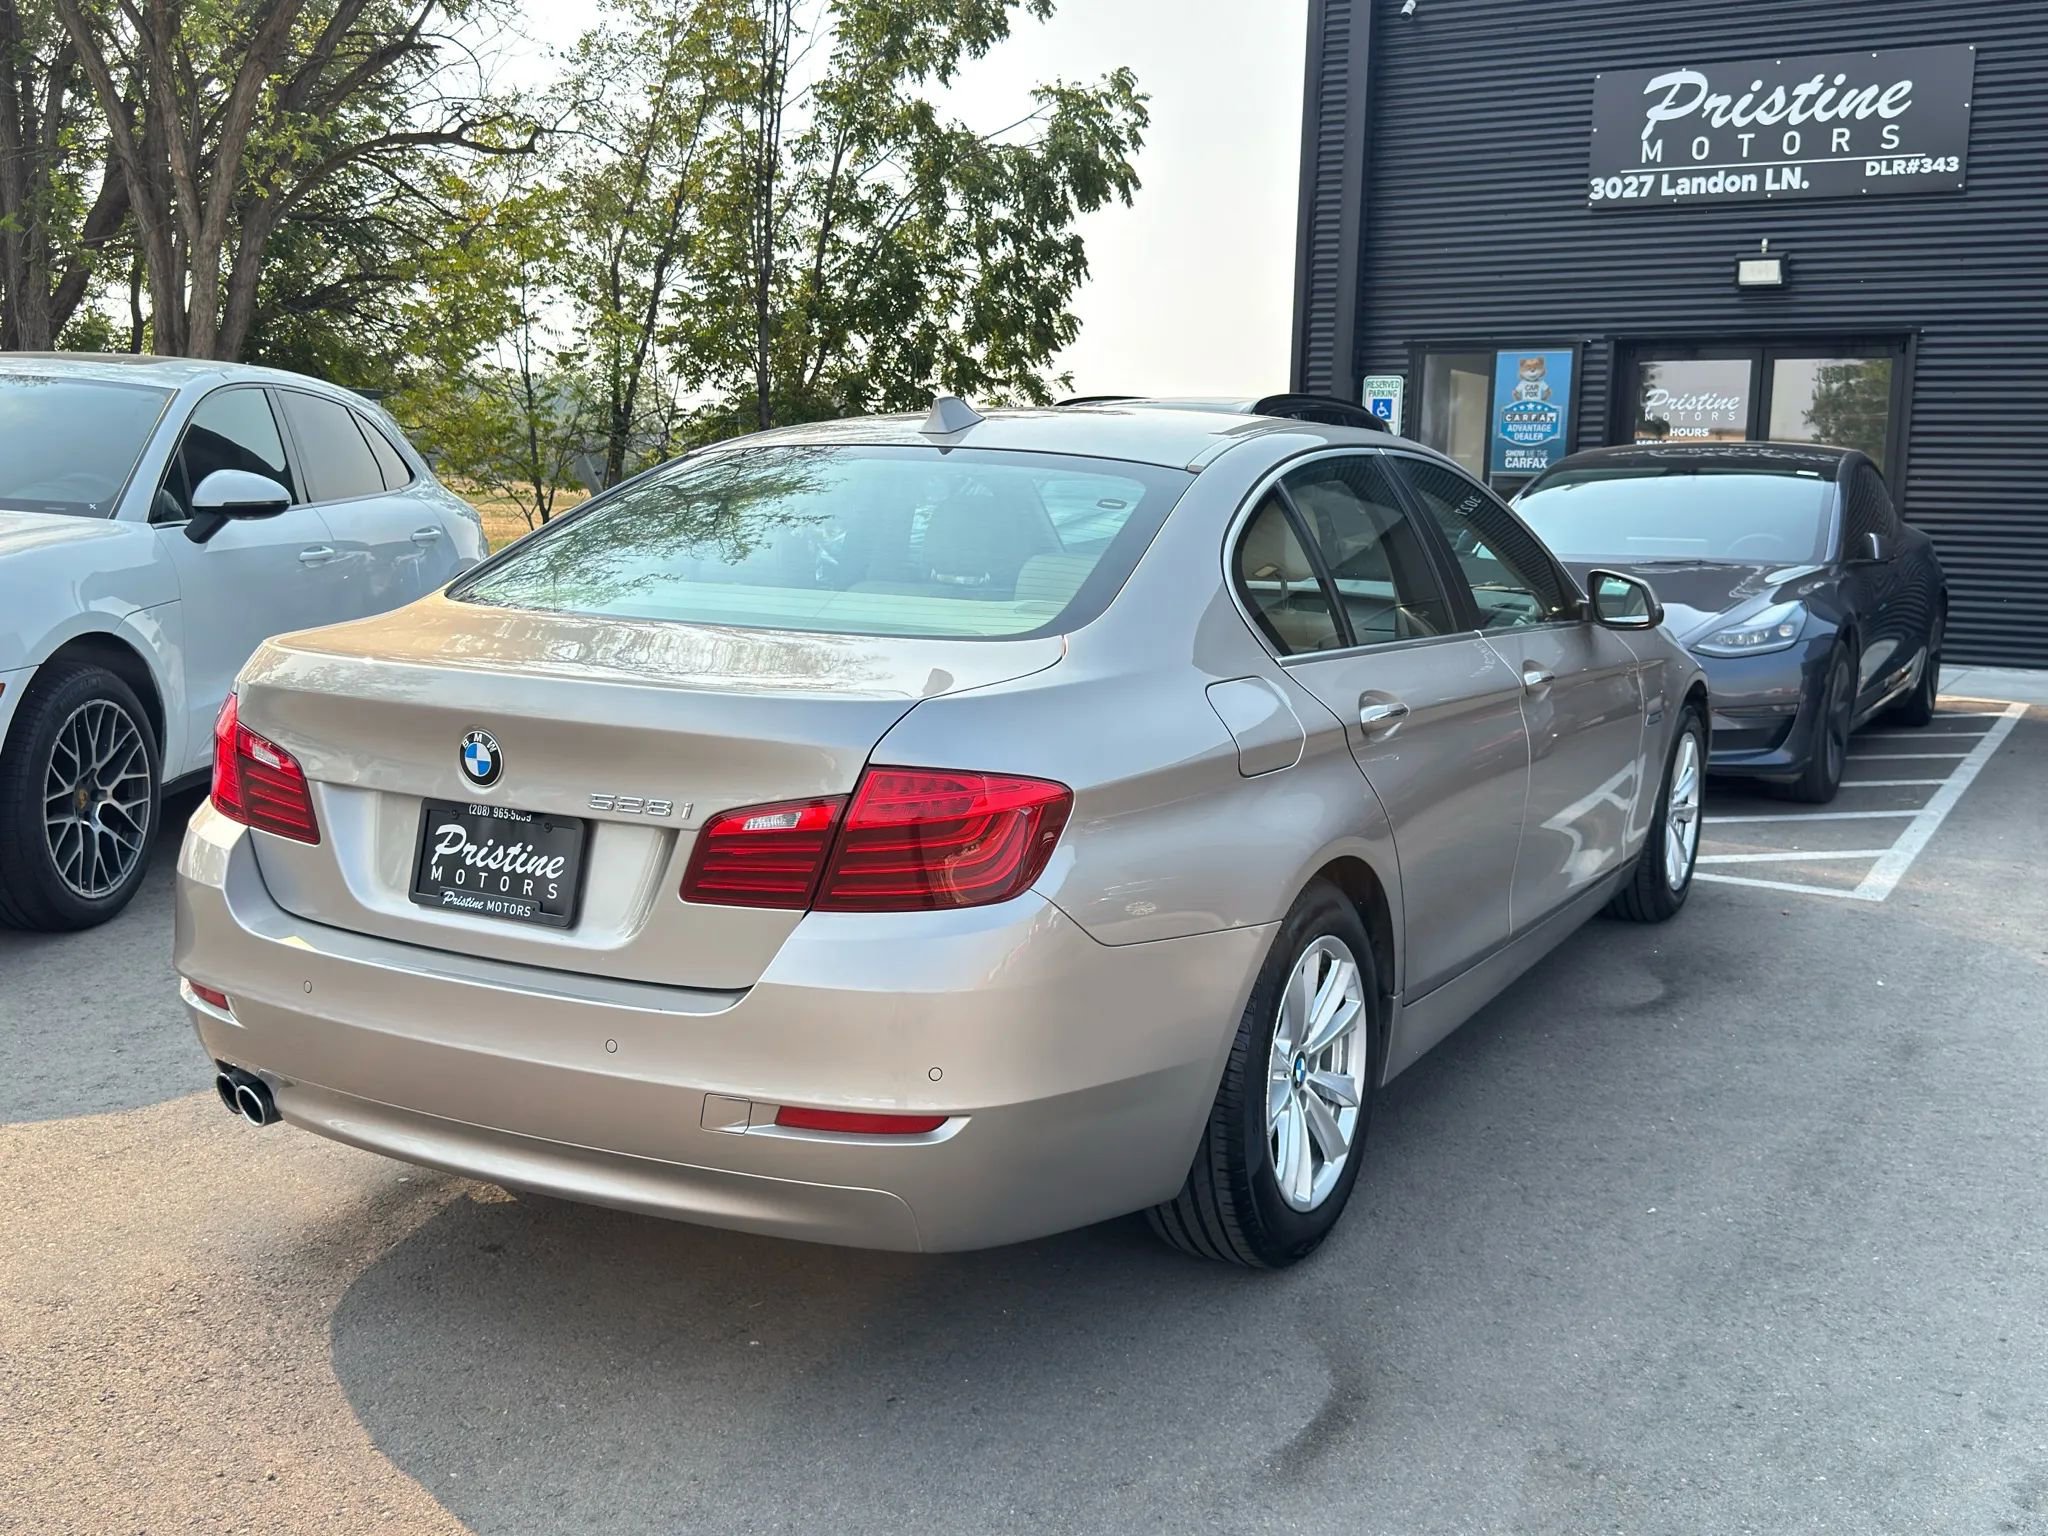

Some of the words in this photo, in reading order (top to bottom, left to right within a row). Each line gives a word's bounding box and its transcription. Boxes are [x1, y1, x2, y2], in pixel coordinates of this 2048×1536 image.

[1641, 70, 1913, 140] Pristine
[1641, 124, 1900, 163] MOTORS
[1865, 156, 1960, 177] DLR#343
[1589, 175, 1654, 200] 3027
[1661, 171, 1758, 196] Landon
[1765, 167, 1809, 191] LN.
[1366, 380, 1400, 389] RESERVED
[1525, 384, 1539, 392] CAR
[1368, 389, 1398, 398] PARKING
[1646, 389, 1740, 413] Pristine
[1504, 413, 1557, 423] CARFAX
[1645, 411, 1736, 422] MOTORS
[1507, 423, 1552, 433] ADVANTAGE
[1670, 427, 1709, 437] HOURS
[1514, 432, 1544, 441] DEALER
[1505, 449, 1525, 457] SHOW
[1526, 449, 1536, 457] ME
[1537, 449, 1549, 457] THE
[1504, 457, 1549, 469] CARFAX
[462, 732, 498, 753] BMW
[469, 803, 490, 817] (208)
[430, 824, 565, 879] Pristine
[430, 865, 558, 900] MOTORS
[442, 890, 484, 910] Pristine
[486, 899, 531, 917] MOTORS
